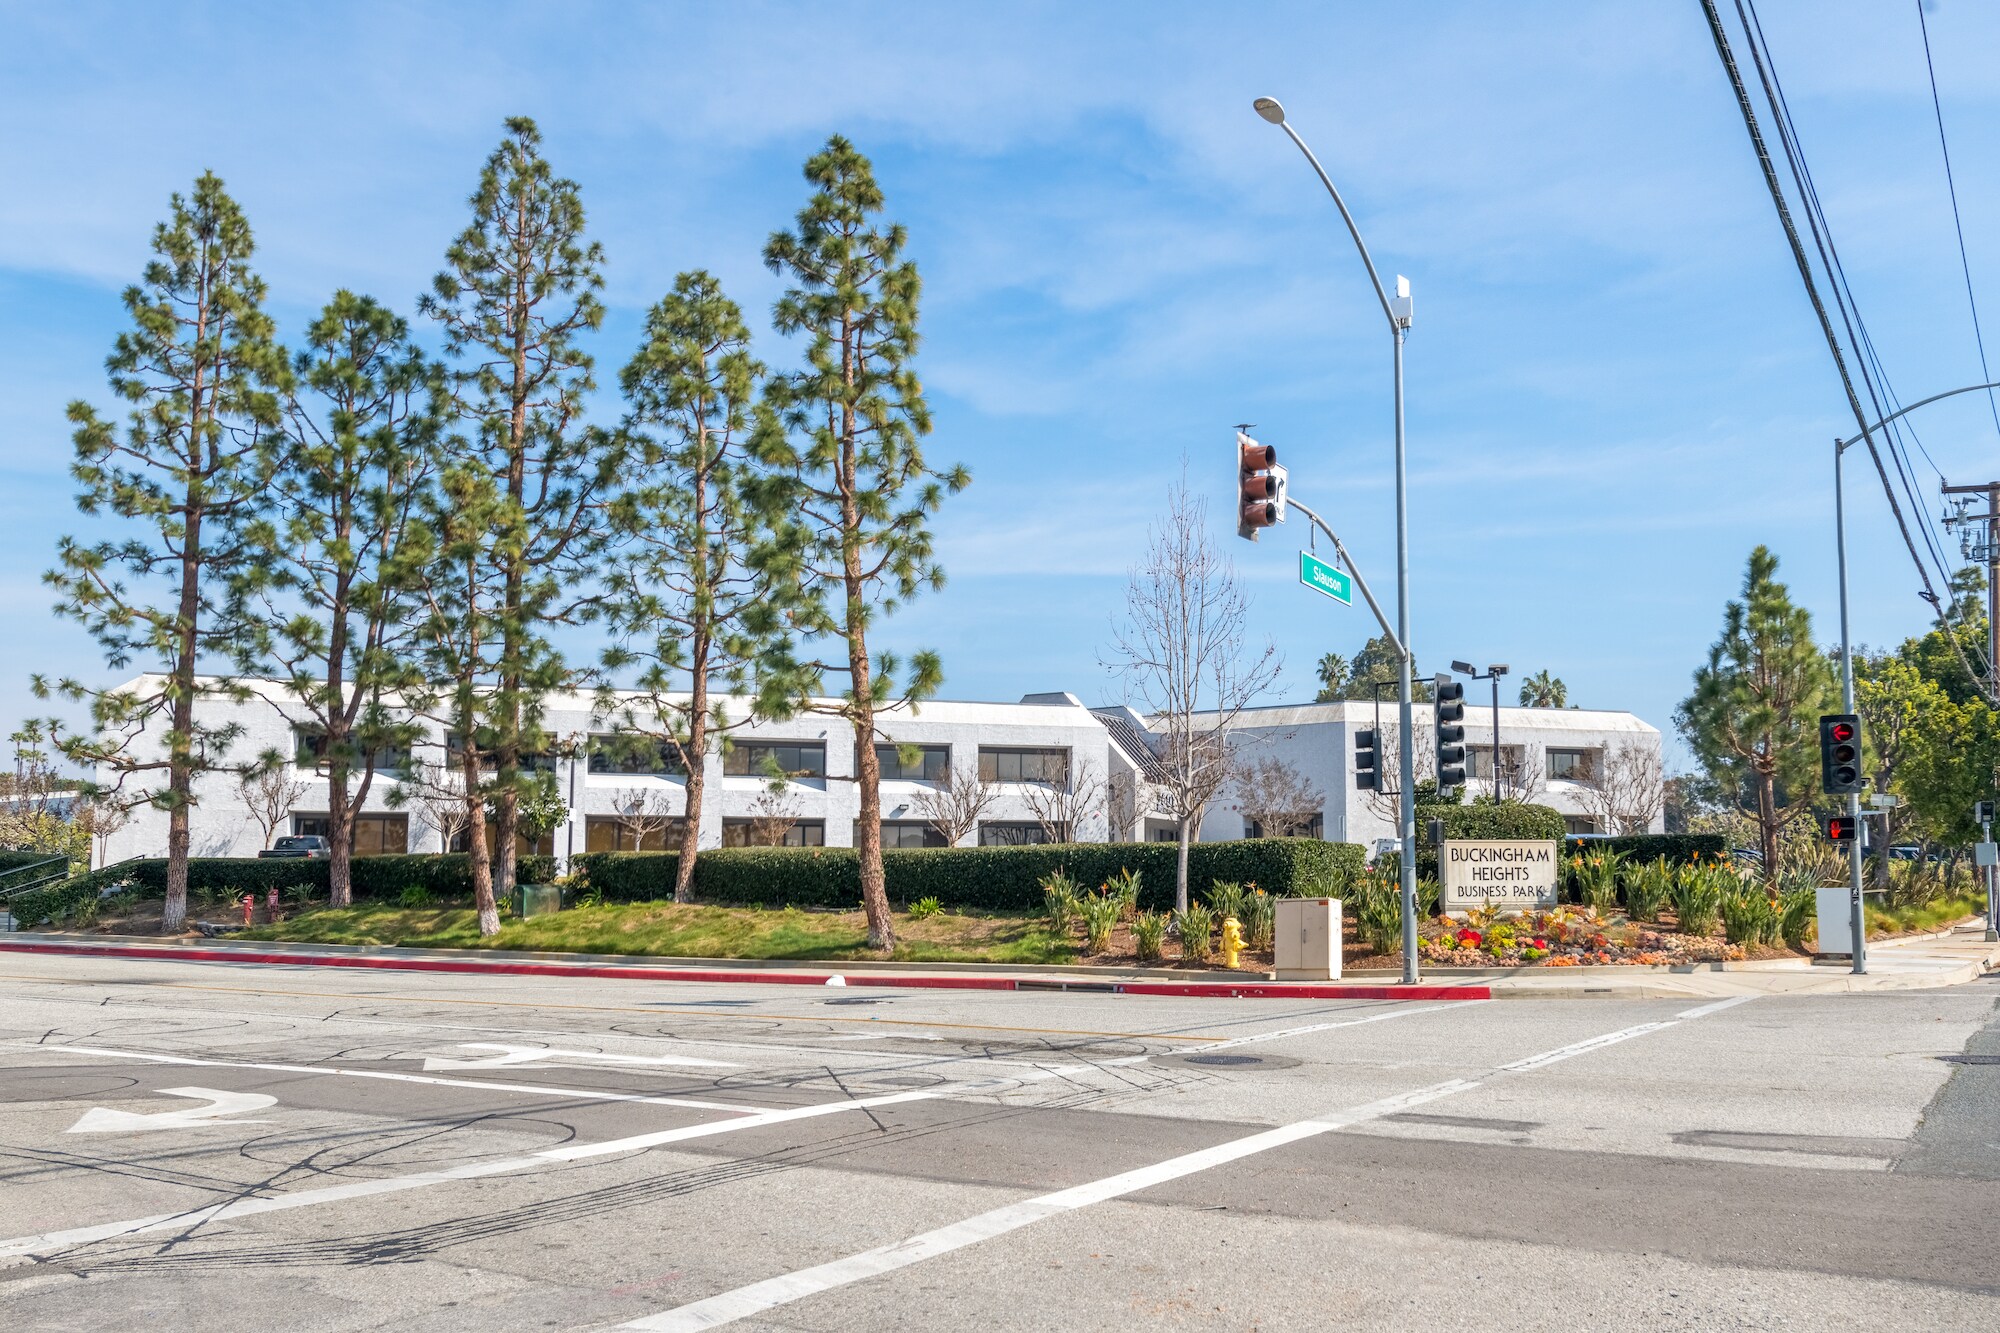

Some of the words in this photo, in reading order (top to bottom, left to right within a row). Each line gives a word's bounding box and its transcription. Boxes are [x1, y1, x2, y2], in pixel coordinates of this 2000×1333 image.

[1313, 565, 1342, 594] Slauson
[1451, 848, 1549, 862] BUCKINGHAM
[1472, 867, 1529, 881] HEIGHTS
[1458, 885, 1507, 897] BUSINESS
[1513, 885, 1544, 897] PARK
